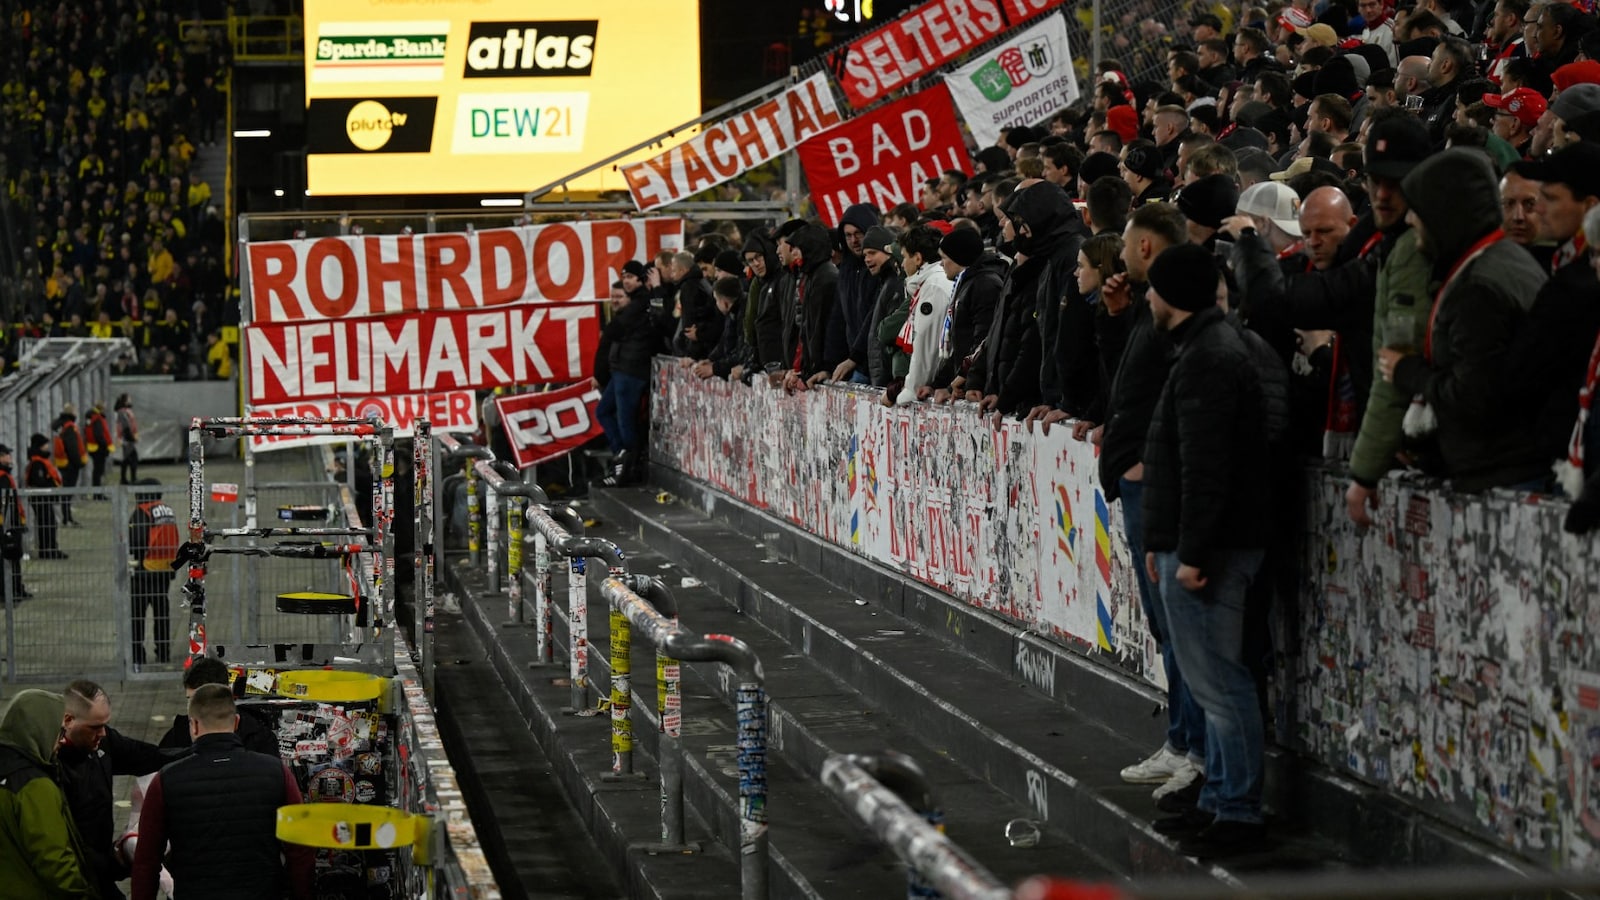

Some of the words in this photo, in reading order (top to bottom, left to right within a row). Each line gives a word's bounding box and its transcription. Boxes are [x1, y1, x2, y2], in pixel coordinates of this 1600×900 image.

[317, 37, 445, 61] Sparda-Bank
[467, 28, 593, 71] atlas
[846, 0, 1001, 98] SELTERS
[471, 106, 572, 138] DEW21
[992, 75, 1069, 124] SUPPORTERS
[622, 79, 841, 210] EYACHTAL
[828, 109, 931, 178] BAD
[248, 305, 596, 400] NEUMARKT
